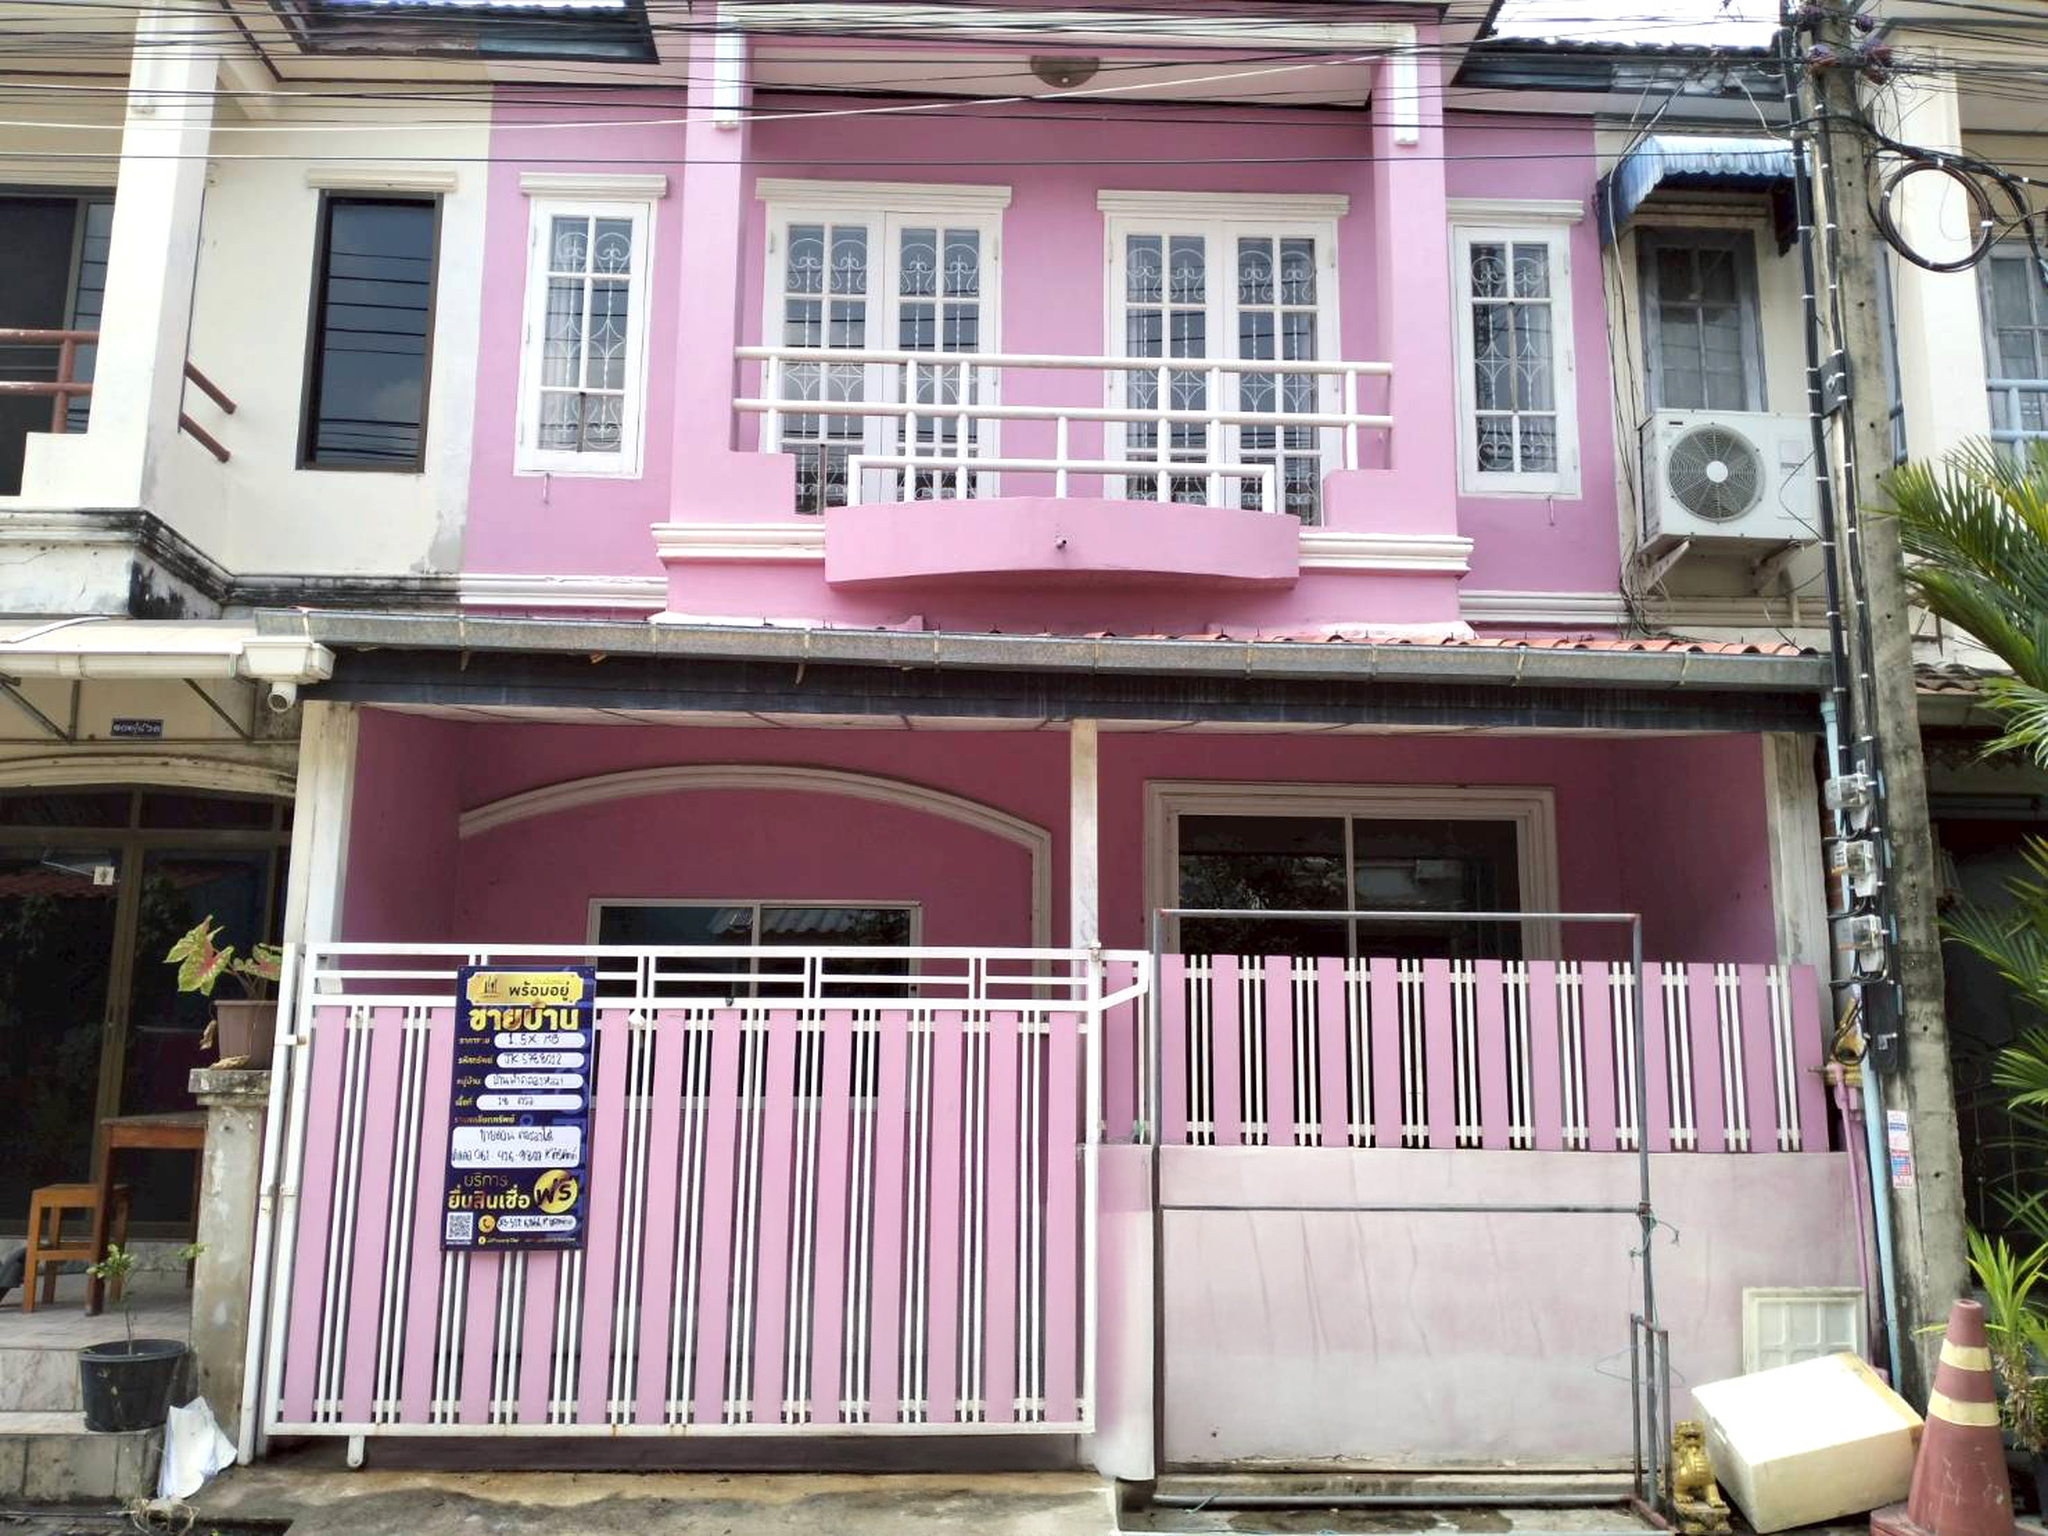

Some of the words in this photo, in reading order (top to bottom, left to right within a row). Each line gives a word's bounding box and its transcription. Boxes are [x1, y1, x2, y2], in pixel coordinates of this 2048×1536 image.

[509, 981, 570, 1001] พร้อมอยู่
[464, 1172, 508, 1187] บริการ
[448, 1185, 530, 1209] ยื่นสินเชื่อ
